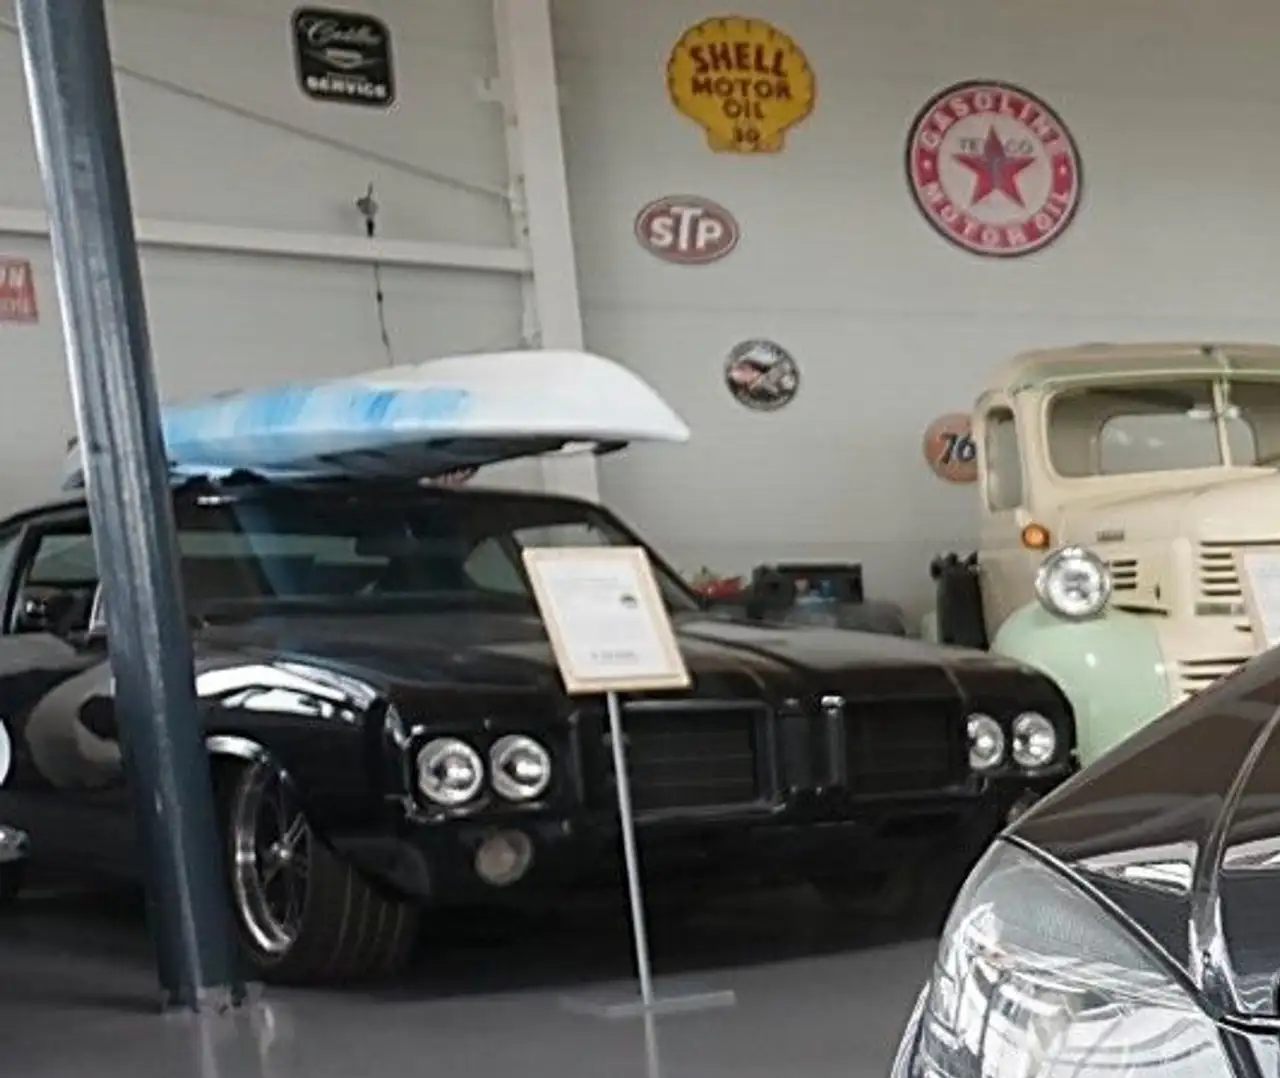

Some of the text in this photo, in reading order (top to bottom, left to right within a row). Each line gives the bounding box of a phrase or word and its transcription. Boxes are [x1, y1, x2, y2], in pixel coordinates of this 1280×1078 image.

[690, 42, 788, 78] SHELL
[307, 76, 387, 98] SERVICE
[691, 76, 792, 100] MOTOR
[723, 98, 764, 119] OIL
[1035, 192, 1069, 232] OIL
[649, 207, 724, 251] STP
[940, 432, 976, 462] 76
